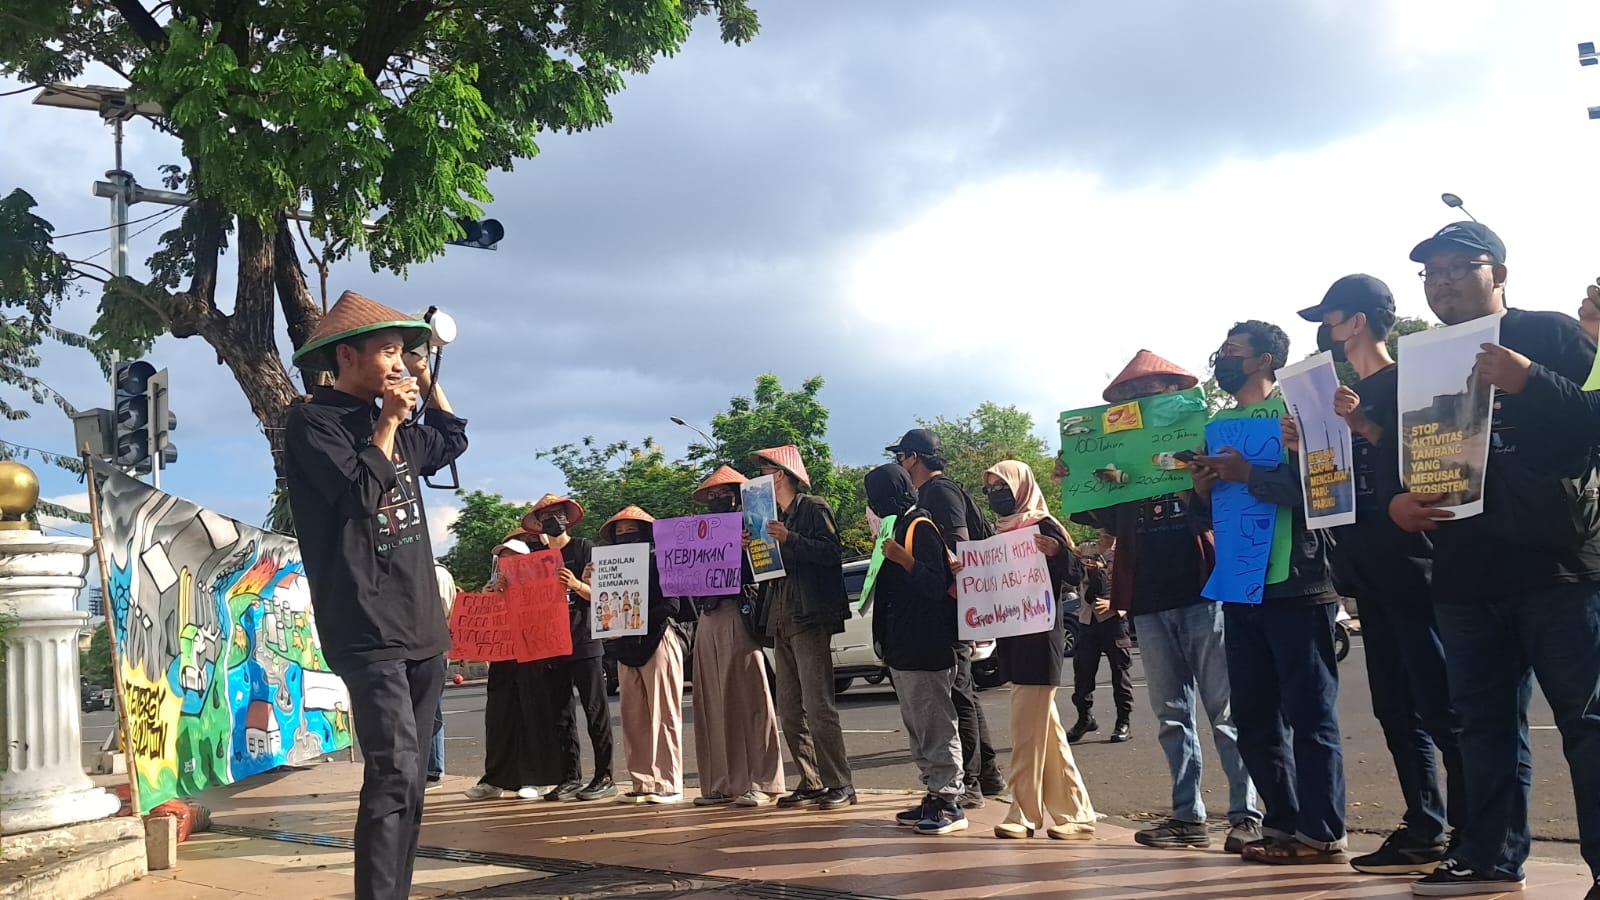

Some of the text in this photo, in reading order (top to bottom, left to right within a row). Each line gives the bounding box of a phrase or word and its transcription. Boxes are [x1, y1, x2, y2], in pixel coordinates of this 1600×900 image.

[1411, 423, 1438, 437] STOP
[1411, 431, 1463, 447] AKTIVITAS
[1411, 444, 1462, 460] TAMBANG
[1410, 460, 1440, 472] YANG
[1410, 468, 1461, 484] MERUSAK
[671, 517, 722, 547] STOP
[599, 557, 634, 565] KEADILAN
[664, 542, 733, 569] KEBIJAKAN
[598, 579, 639, 588] SEMUANYA
[1001, 568, 1047, 590] ABU-ABU
[131, 686, 166, 720] ENERGY
